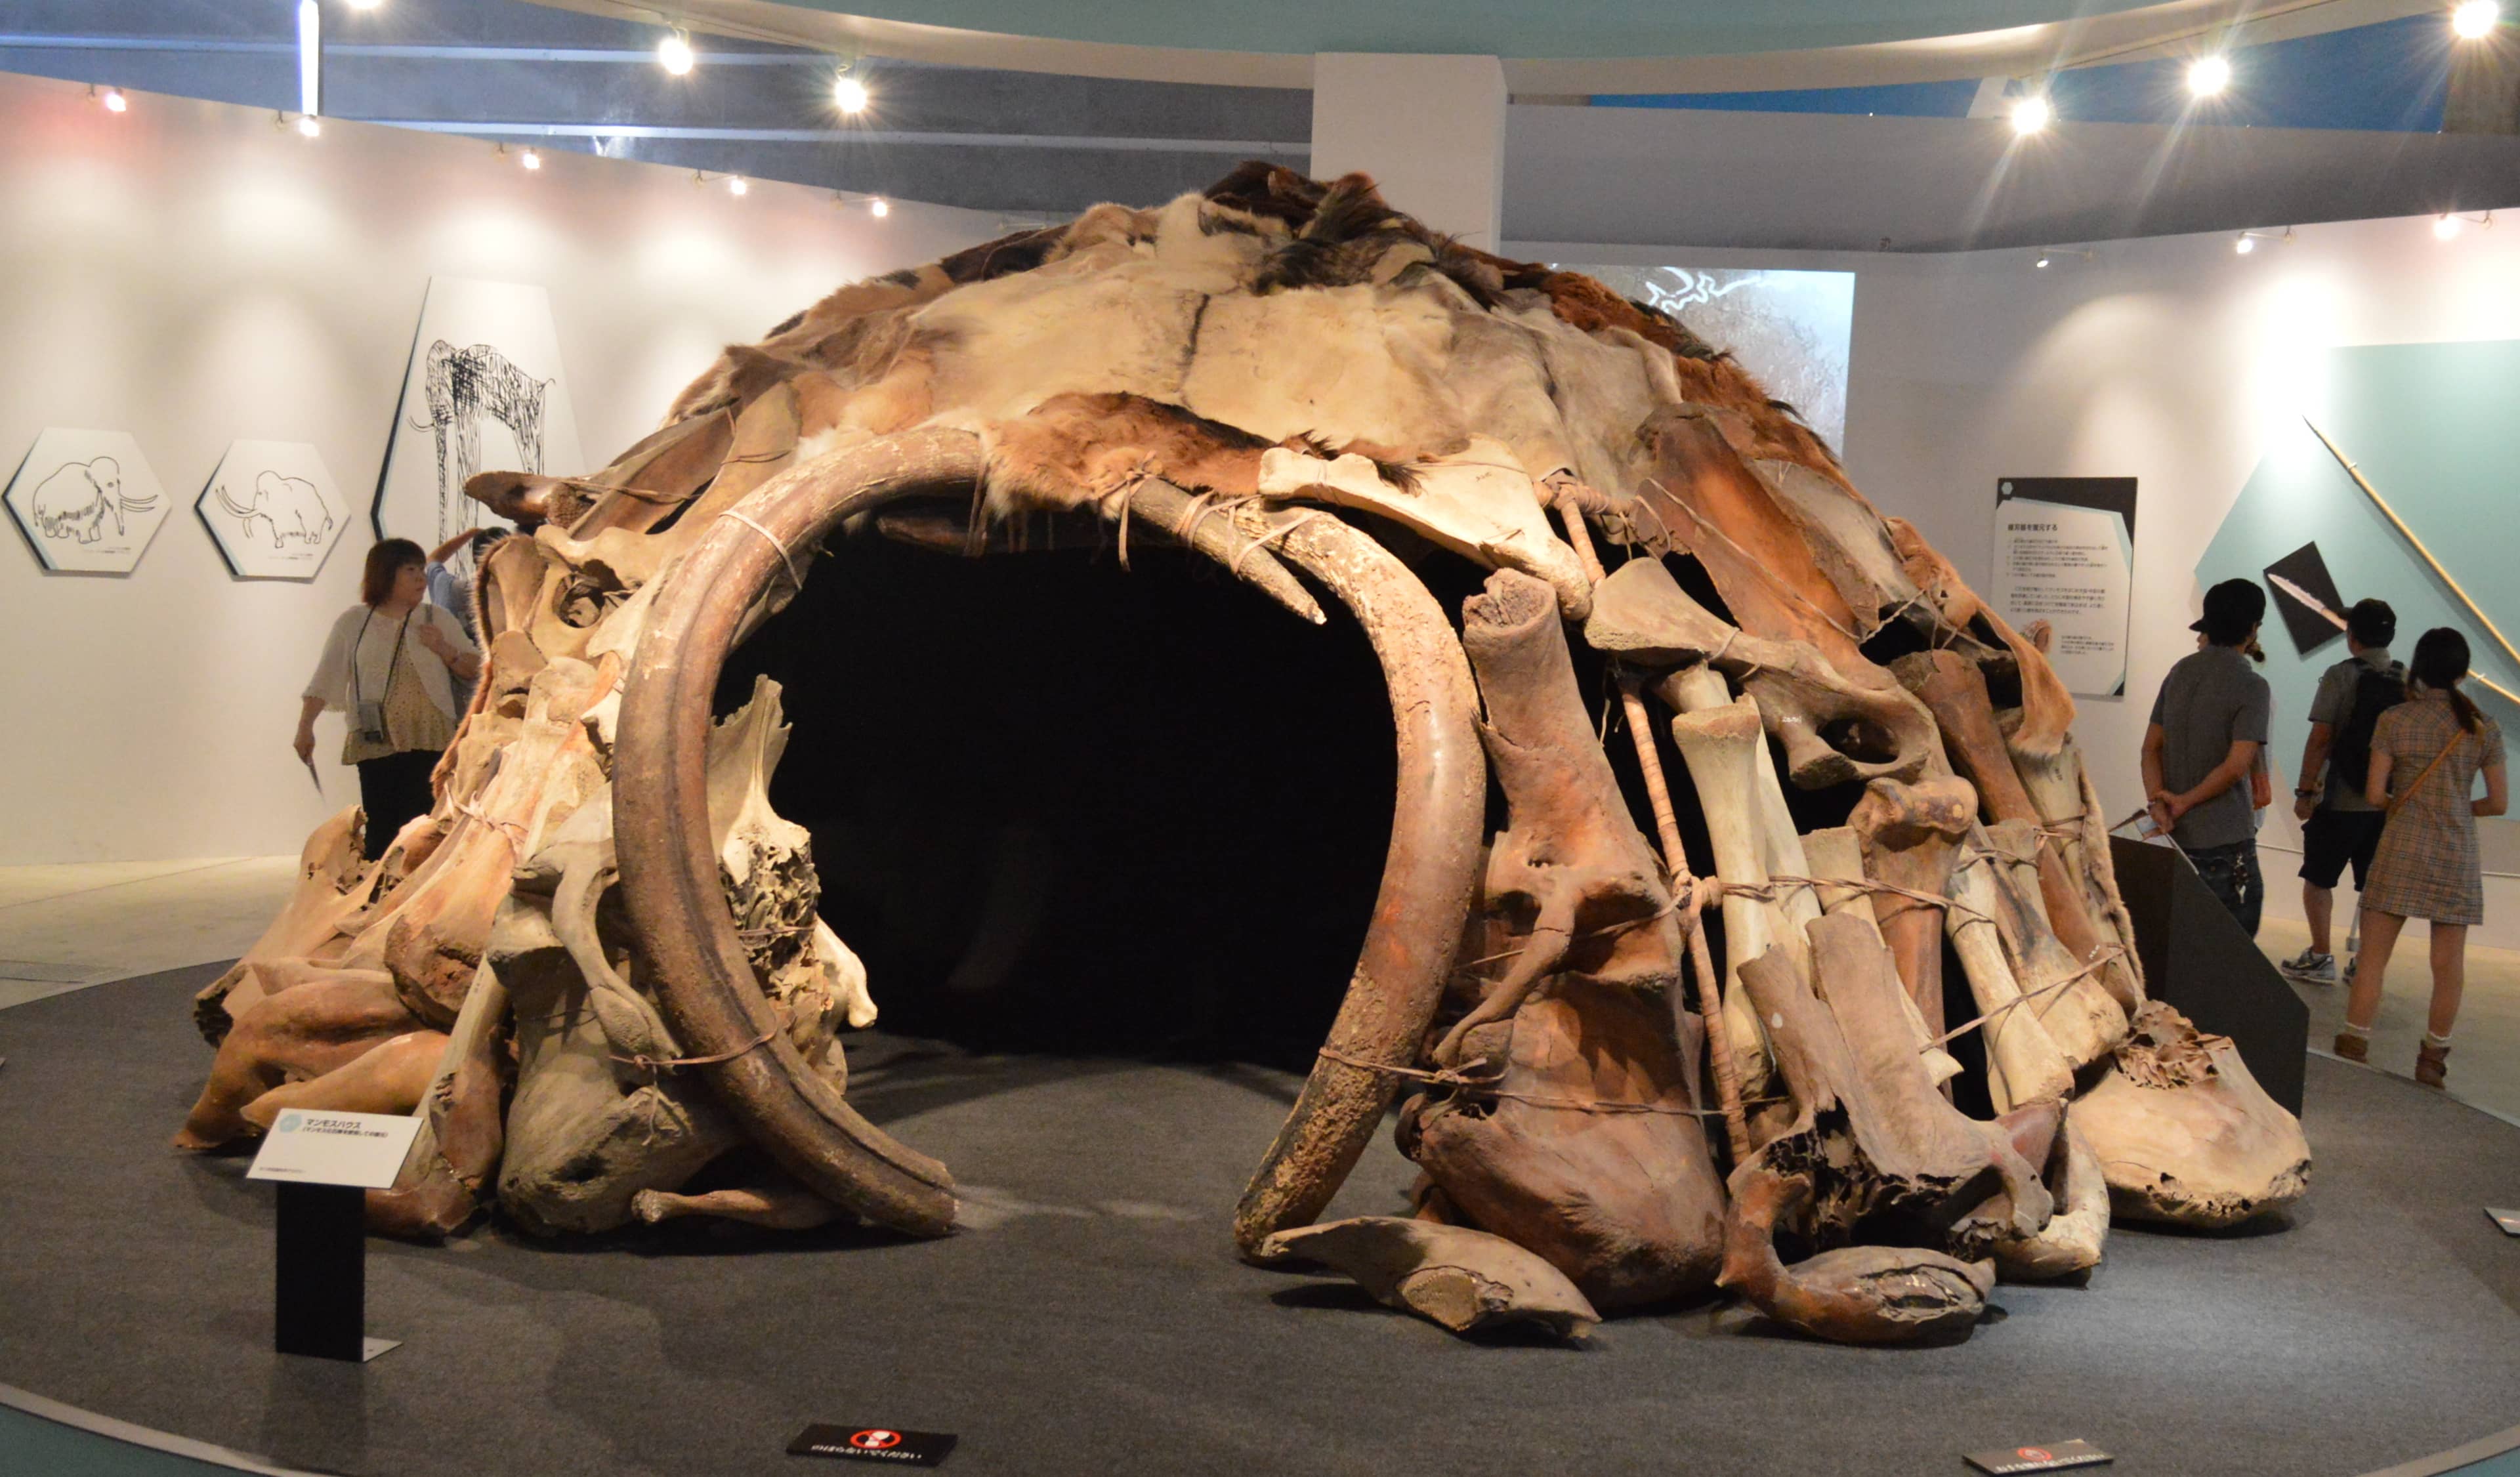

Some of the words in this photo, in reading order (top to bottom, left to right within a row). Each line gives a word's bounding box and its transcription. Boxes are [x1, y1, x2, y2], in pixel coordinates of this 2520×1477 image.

[306, 1118, 362, 1129] マンモスハウス
